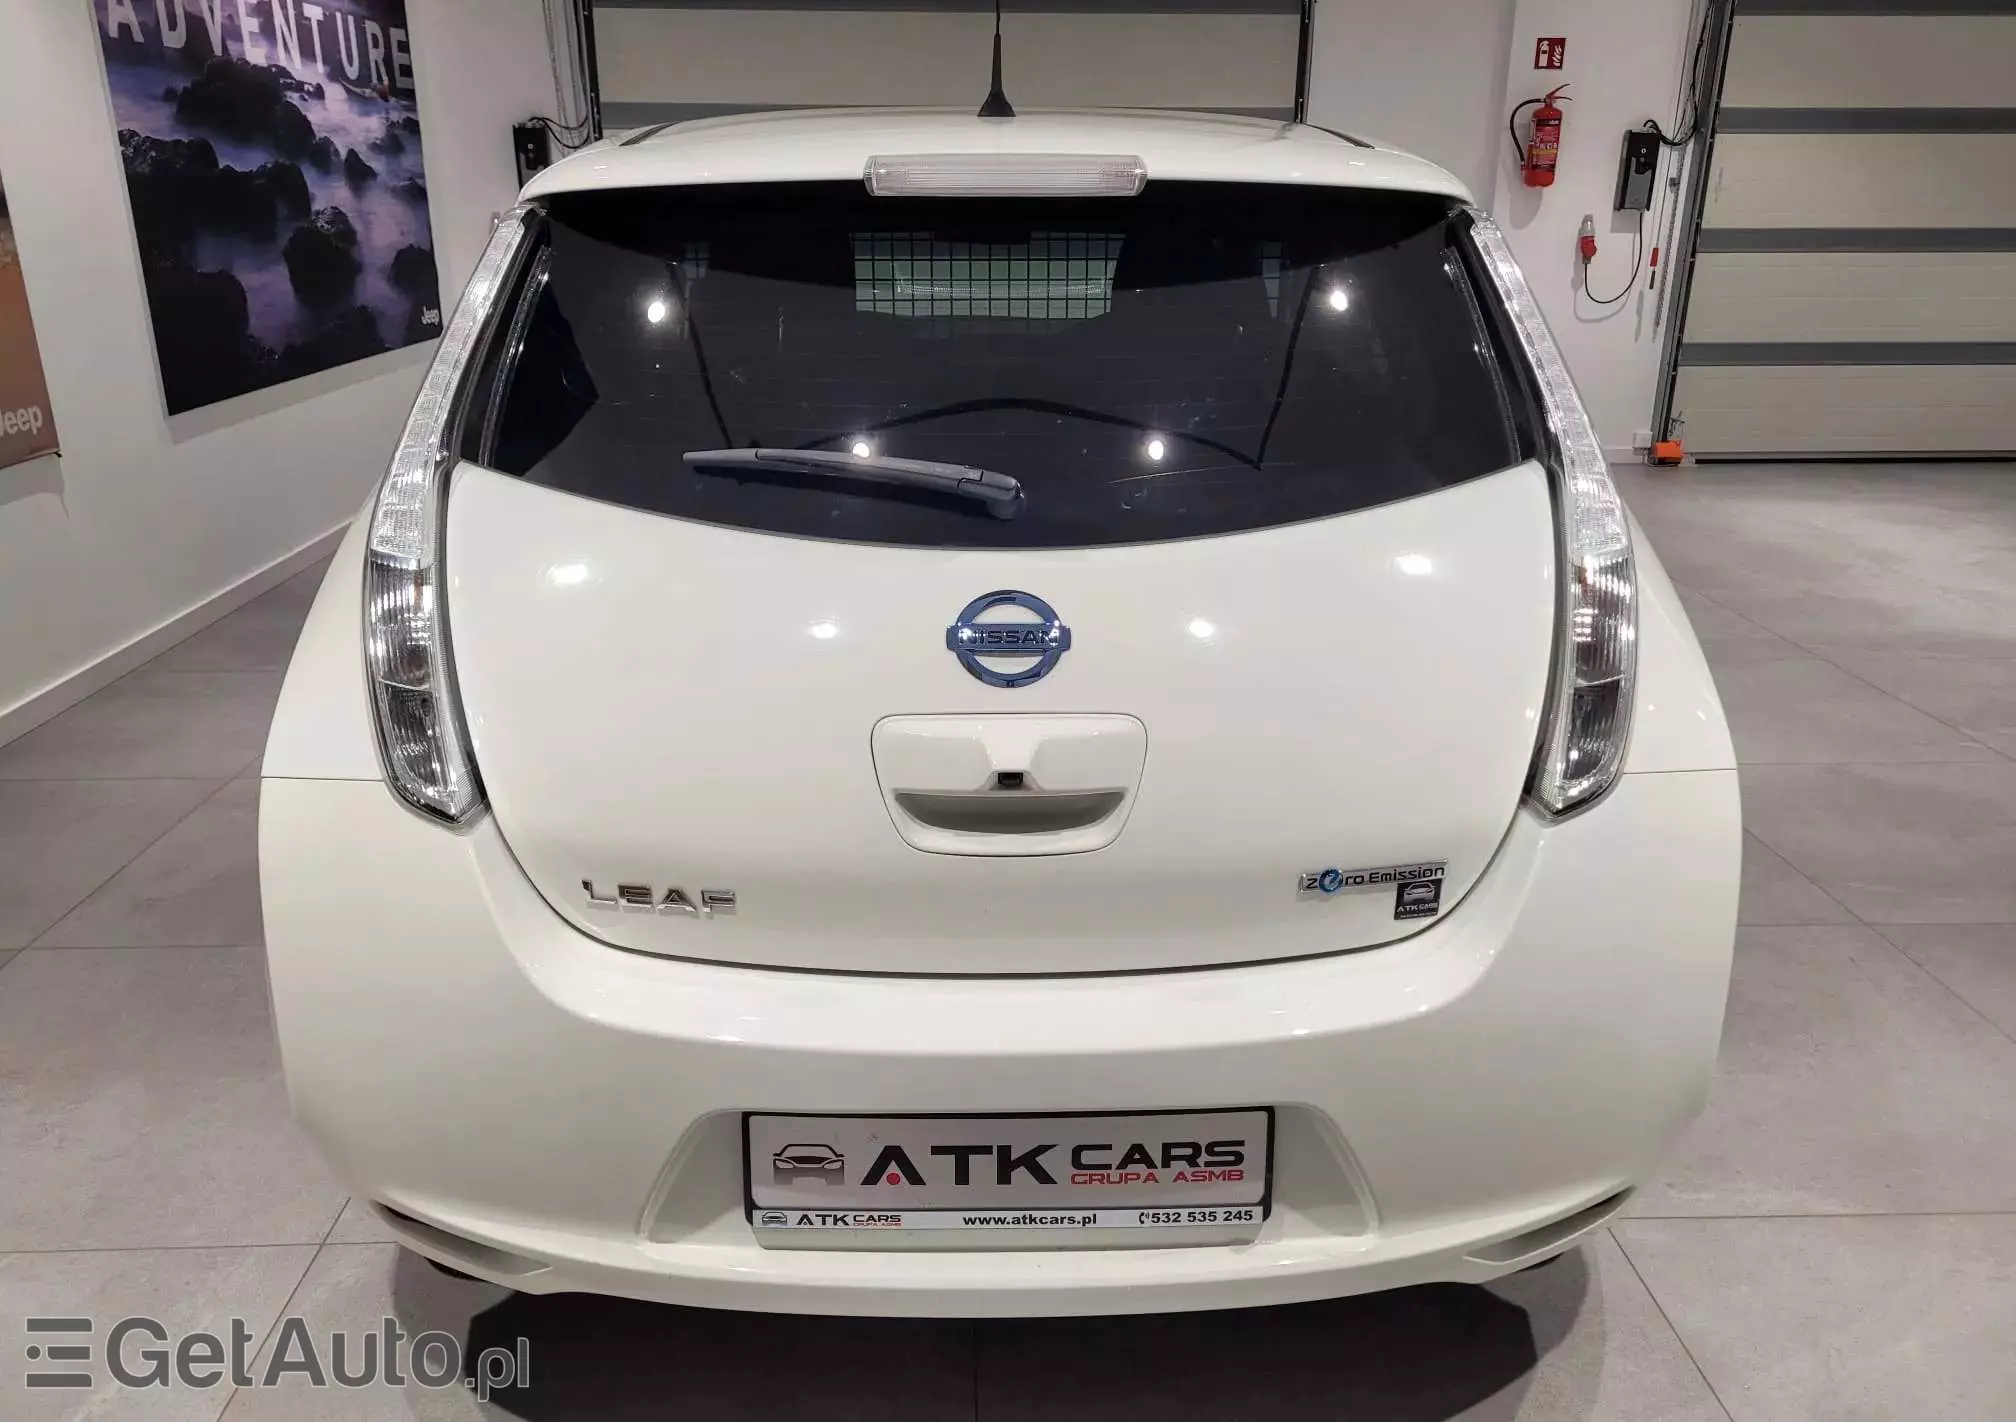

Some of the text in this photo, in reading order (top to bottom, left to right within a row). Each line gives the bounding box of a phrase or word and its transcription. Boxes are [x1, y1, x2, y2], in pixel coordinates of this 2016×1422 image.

[107, 0, 414, 89] ADVENTURE
[421, 305, 440, 326] Jeep
[958, 629, 1060, 645] NISSAN
[1369, 866, 1445, 882] Emission
[581, 879, 736, 912] LEAF
[860, 1140, 1246, 1186] ATK CARS
[1070, 1169, 1244, 1184] GRUPA ASMB
[797, 1214, 849, 1226] ATK
[853, 1215, 901, 1223] CARS
[963, 1213, 1097, 1227] www.atkcars.pl
[1151, 1210, 1254, 1224] 532 535 245
